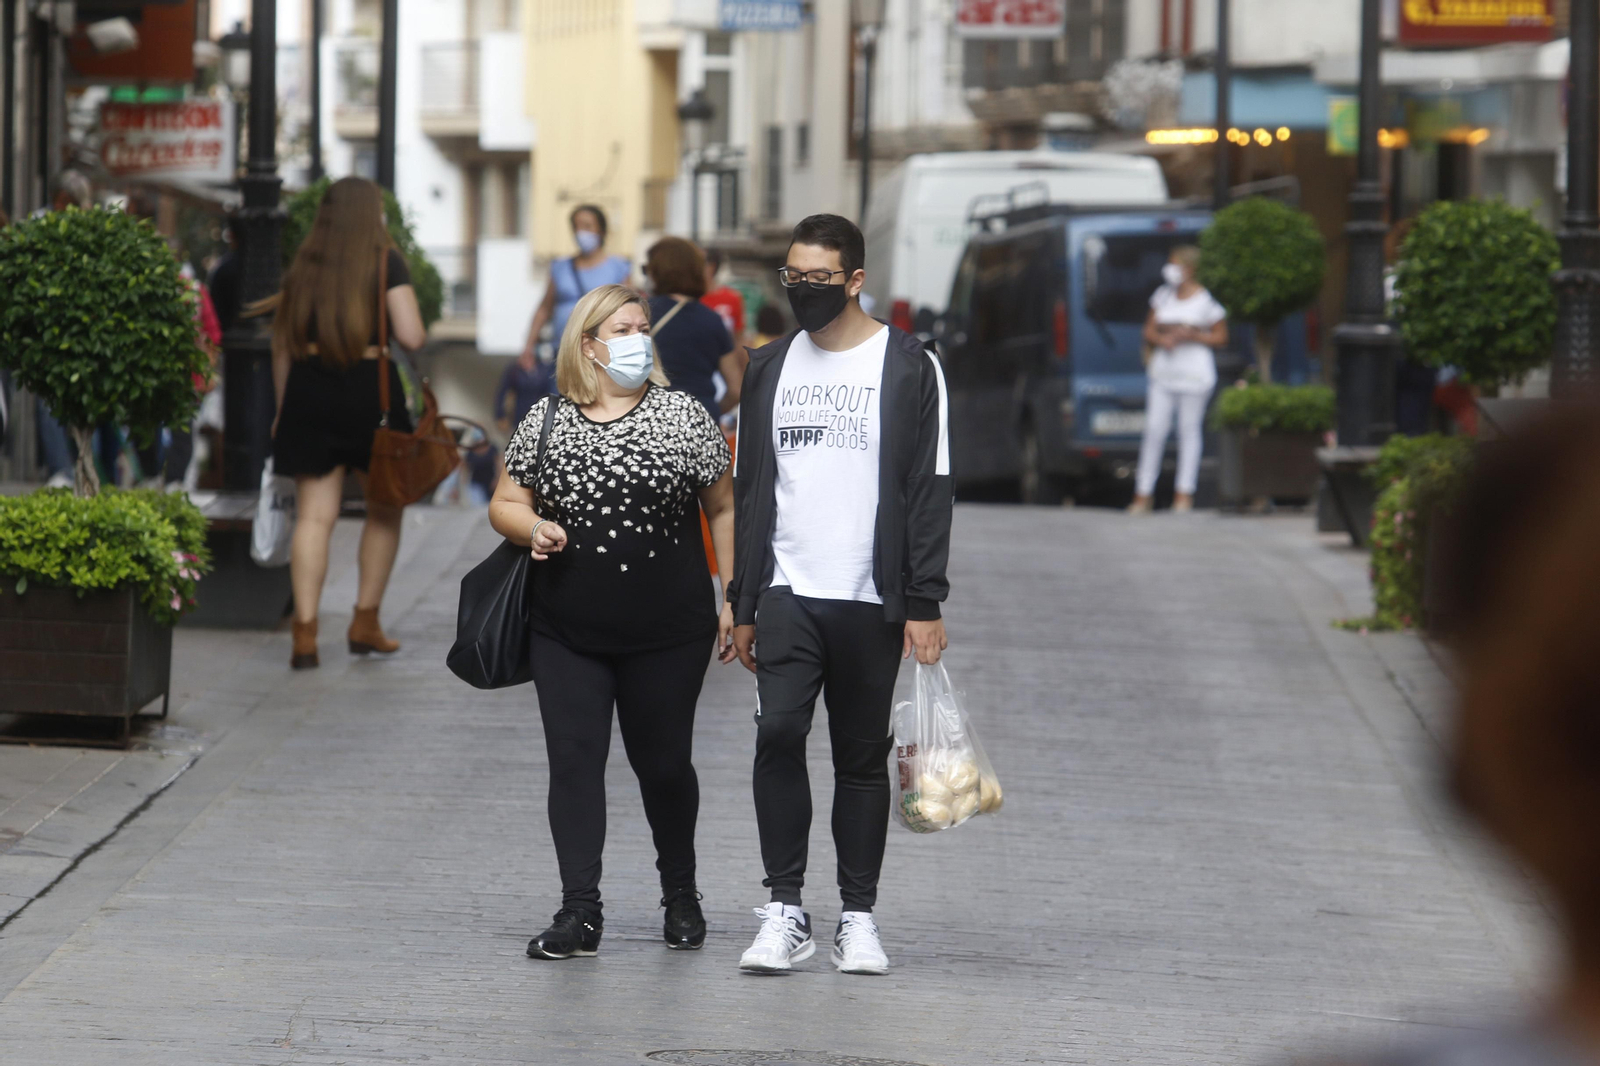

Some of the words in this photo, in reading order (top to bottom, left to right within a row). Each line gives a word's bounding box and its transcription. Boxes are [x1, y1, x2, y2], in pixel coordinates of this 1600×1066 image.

[782, 385, 875, 414] WORKOUT
[779, 410, 805, 423] YOUR
[809, 410, 830, 422] LIFE
[828, 415, 868, 434] ZONE
[826, 432, 868, 450] 00:05
